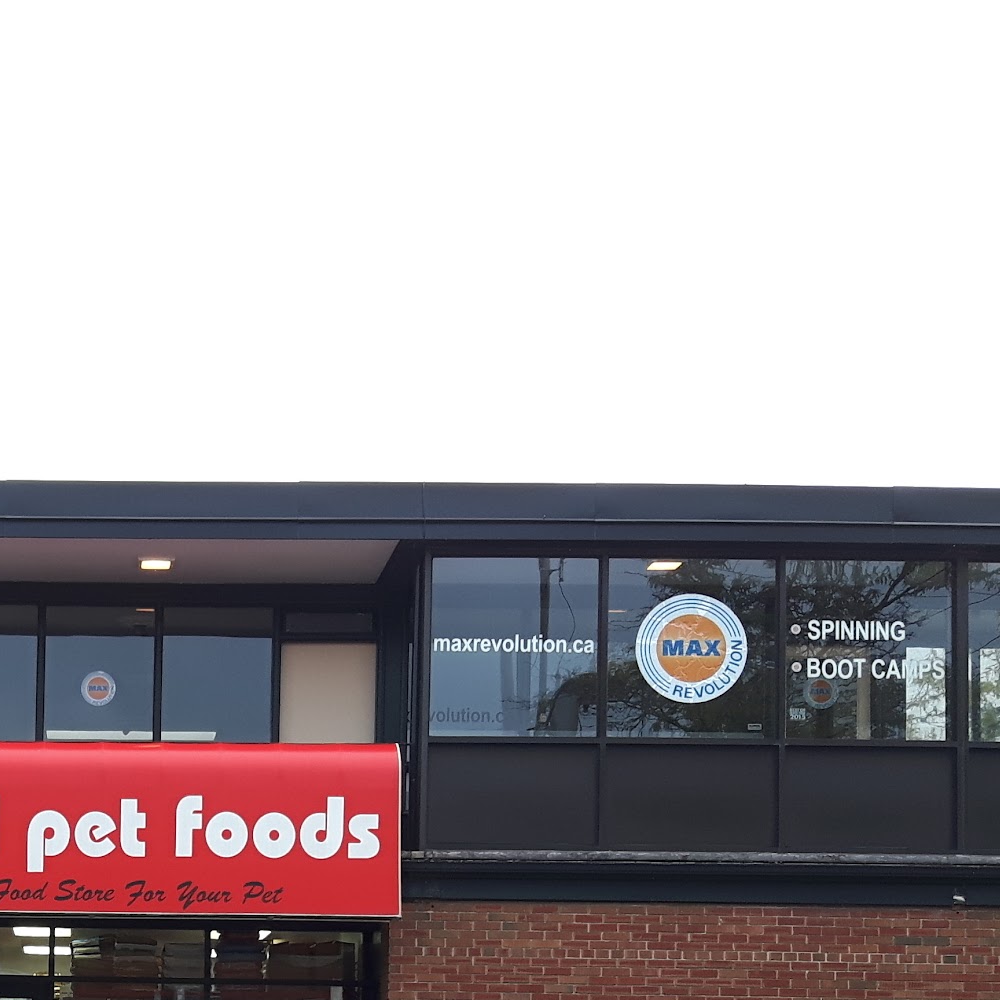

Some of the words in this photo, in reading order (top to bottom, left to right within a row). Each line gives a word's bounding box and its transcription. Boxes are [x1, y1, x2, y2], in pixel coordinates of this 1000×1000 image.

[807, 619, 906, 641] SPINNING
[433, 633, 595, 654] maxrevolution.ca
[662, 639, 721, 657] MAX
[672, 639, 743, 699] REVOLUTION
[806, 657, 867, 679] BOOT
[871, 658, 946, 680] CAMPS
[26, 798, 146, 873] pet
[175, 795, 381, 860] foods
[54, 879, 115, 903] Store
[124, 880, 167, 907] For
[176, 880, 233, 911] Your
[242, 881, 285, 905] Pet
